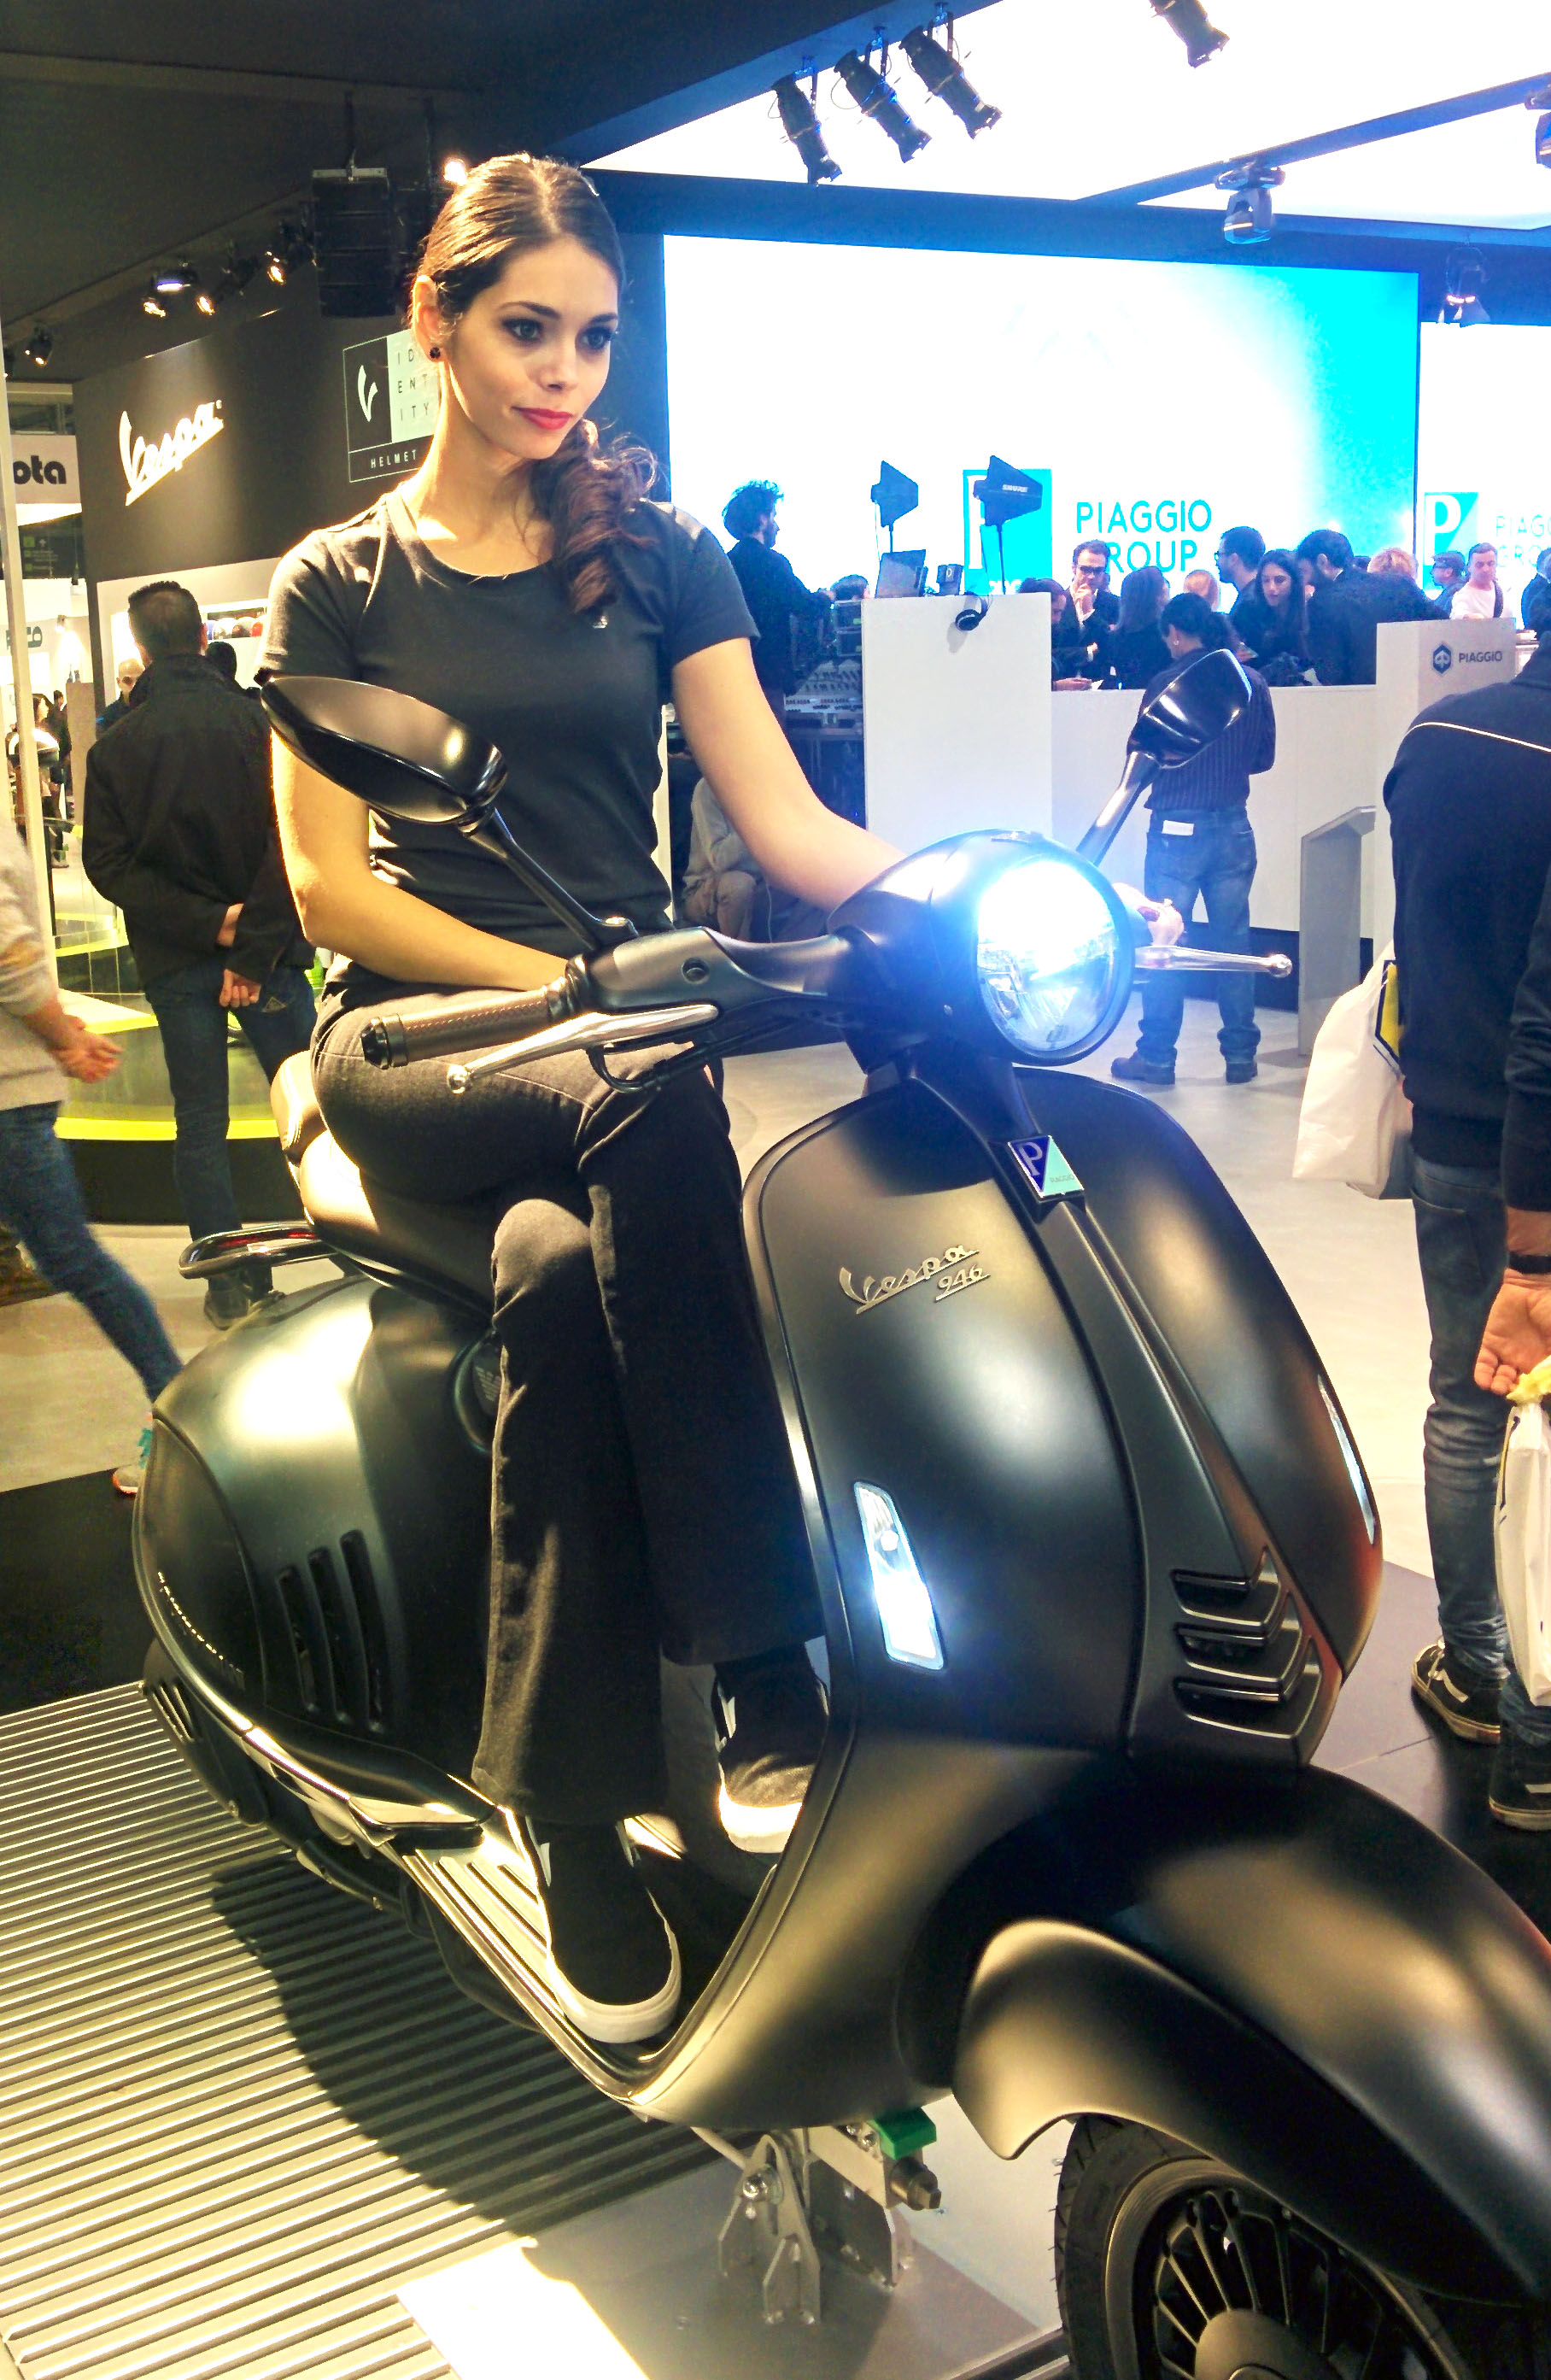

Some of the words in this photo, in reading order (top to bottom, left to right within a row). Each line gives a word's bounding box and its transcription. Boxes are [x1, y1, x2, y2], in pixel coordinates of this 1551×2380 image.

[400, 403, 429, 421] ITY
[119, 401, 224, 506] Vespa
[371, 449, 417, 469] HELMET
[1076, 499, 1212, 533] PIAGGIO
[1105, 539, 1197, 573] ROUP
[1496, 543, 1544, 567] GRO
[1458, 650, 1503, 663] PIAGGIO
[839, 1245, 980, 1315] Vespa
[934, 1264, 992, 1303] 946
